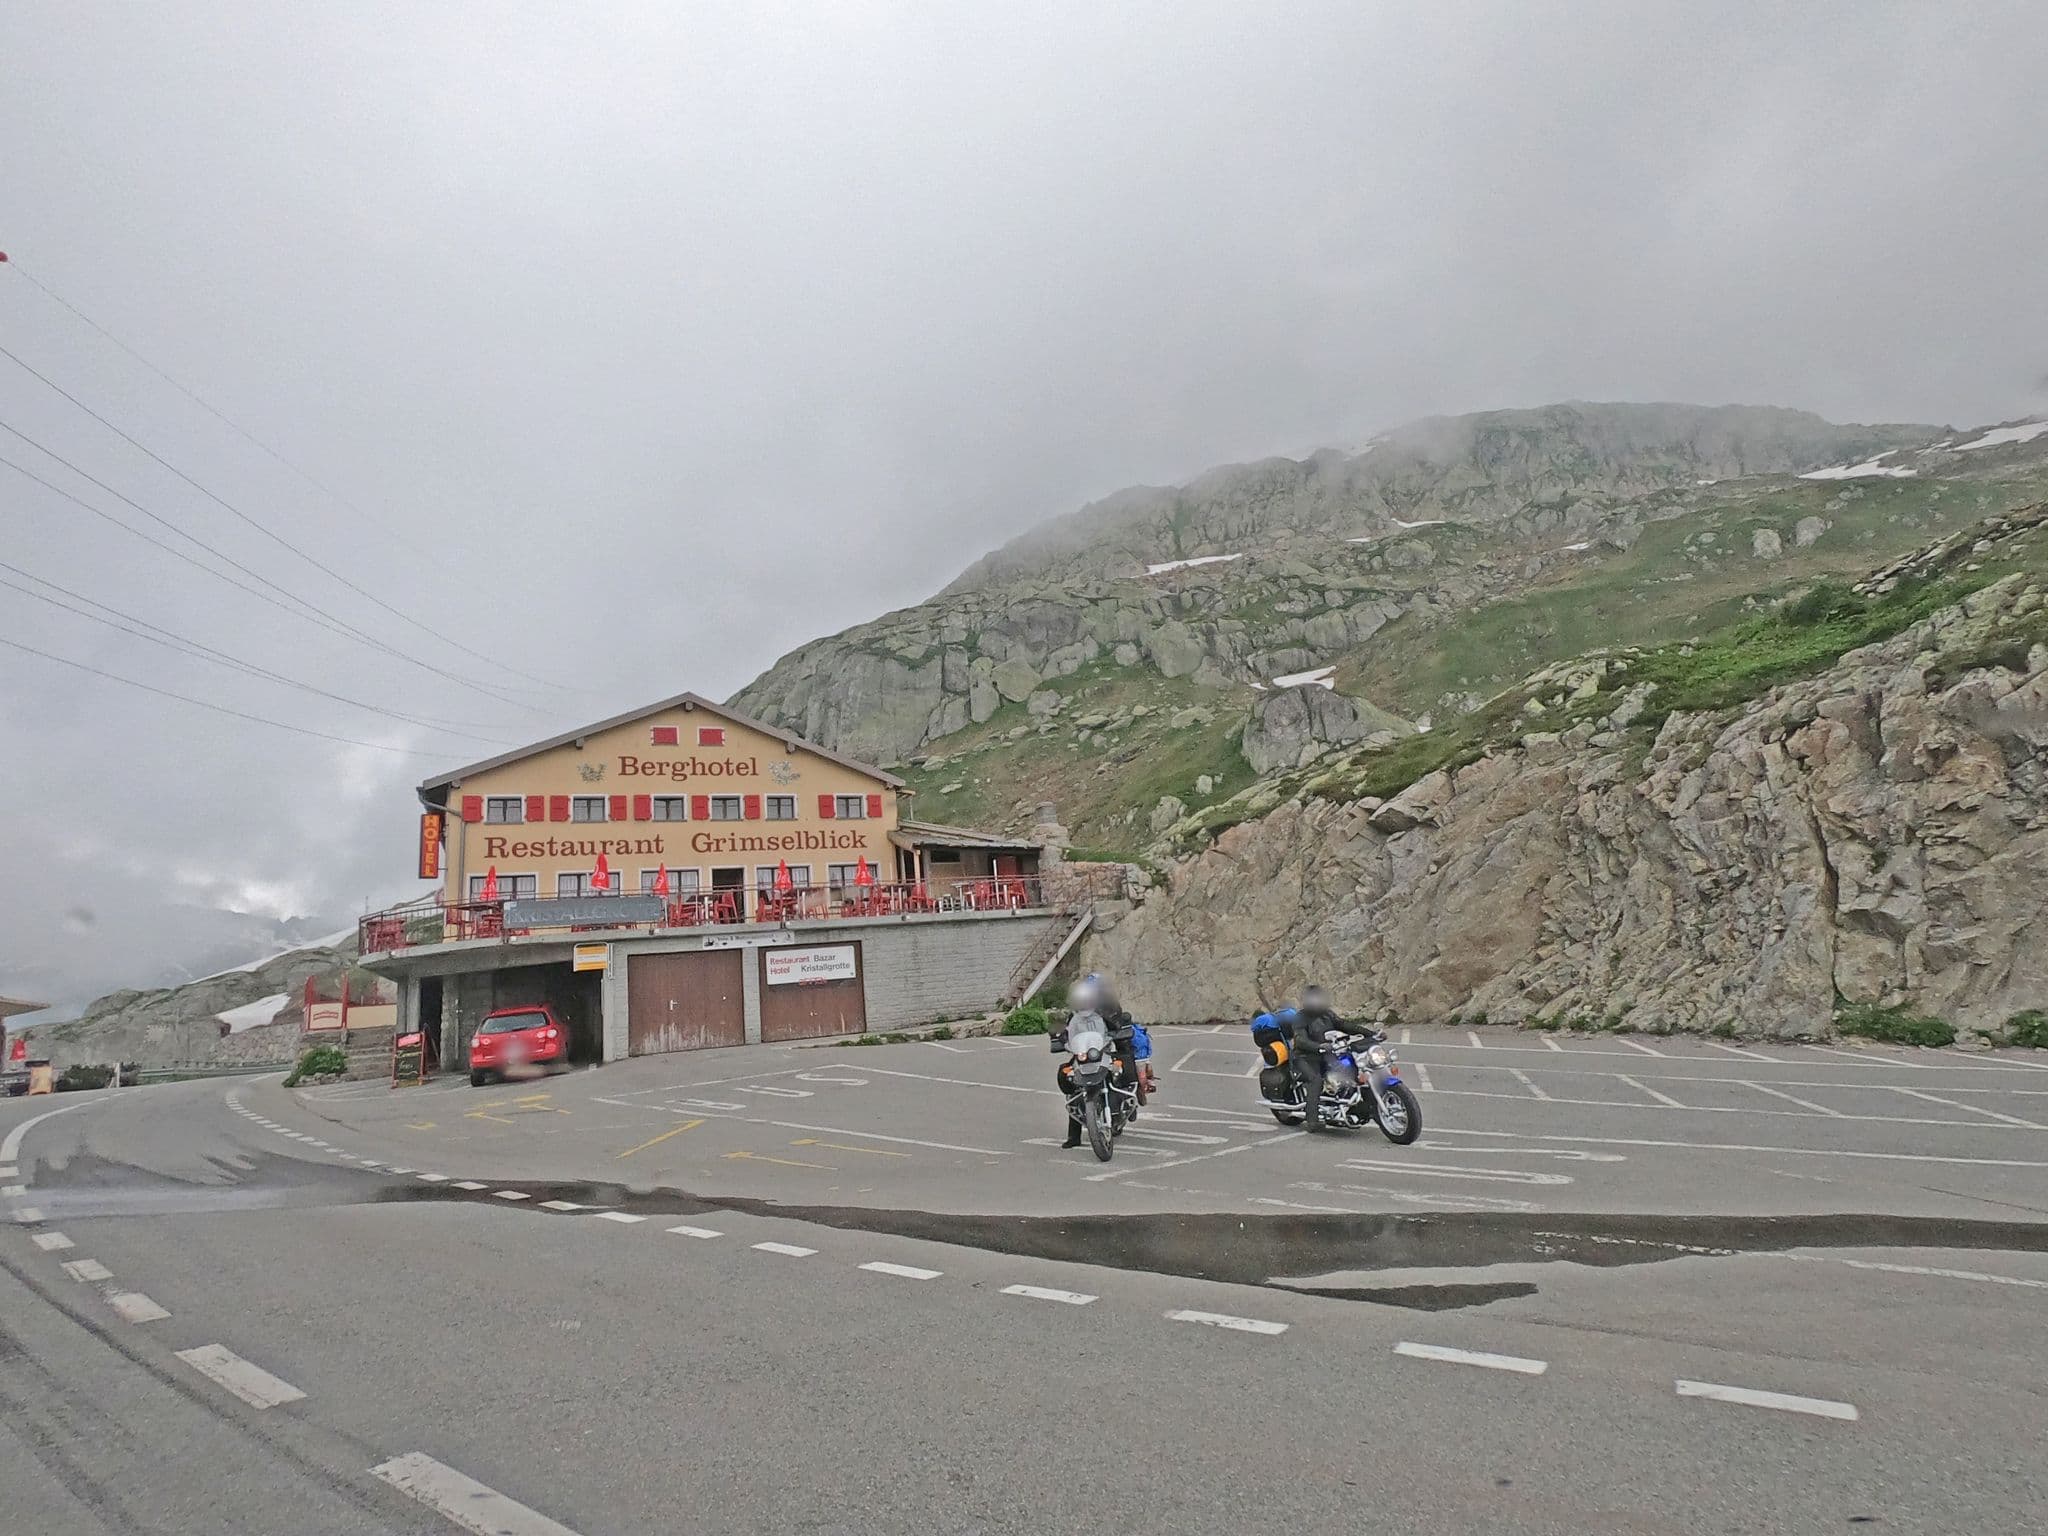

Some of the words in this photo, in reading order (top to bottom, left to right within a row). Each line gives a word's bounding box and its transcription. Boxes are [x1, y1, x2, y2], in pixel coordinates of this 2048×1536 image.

[617, 756, 759, 782] Berghotel
[423, 815, 440, 877] HOTEL
[483, 833, 665, 859] Restaurant
[691, 830, 868, 854] Grimselblick
[769, 955, 810, 966] Restaurant
[813, 954, 836, 963] Bazar
[770, 966, 791, 975] Hotel
[801, 961, 850, 973] Kristallgrotte
